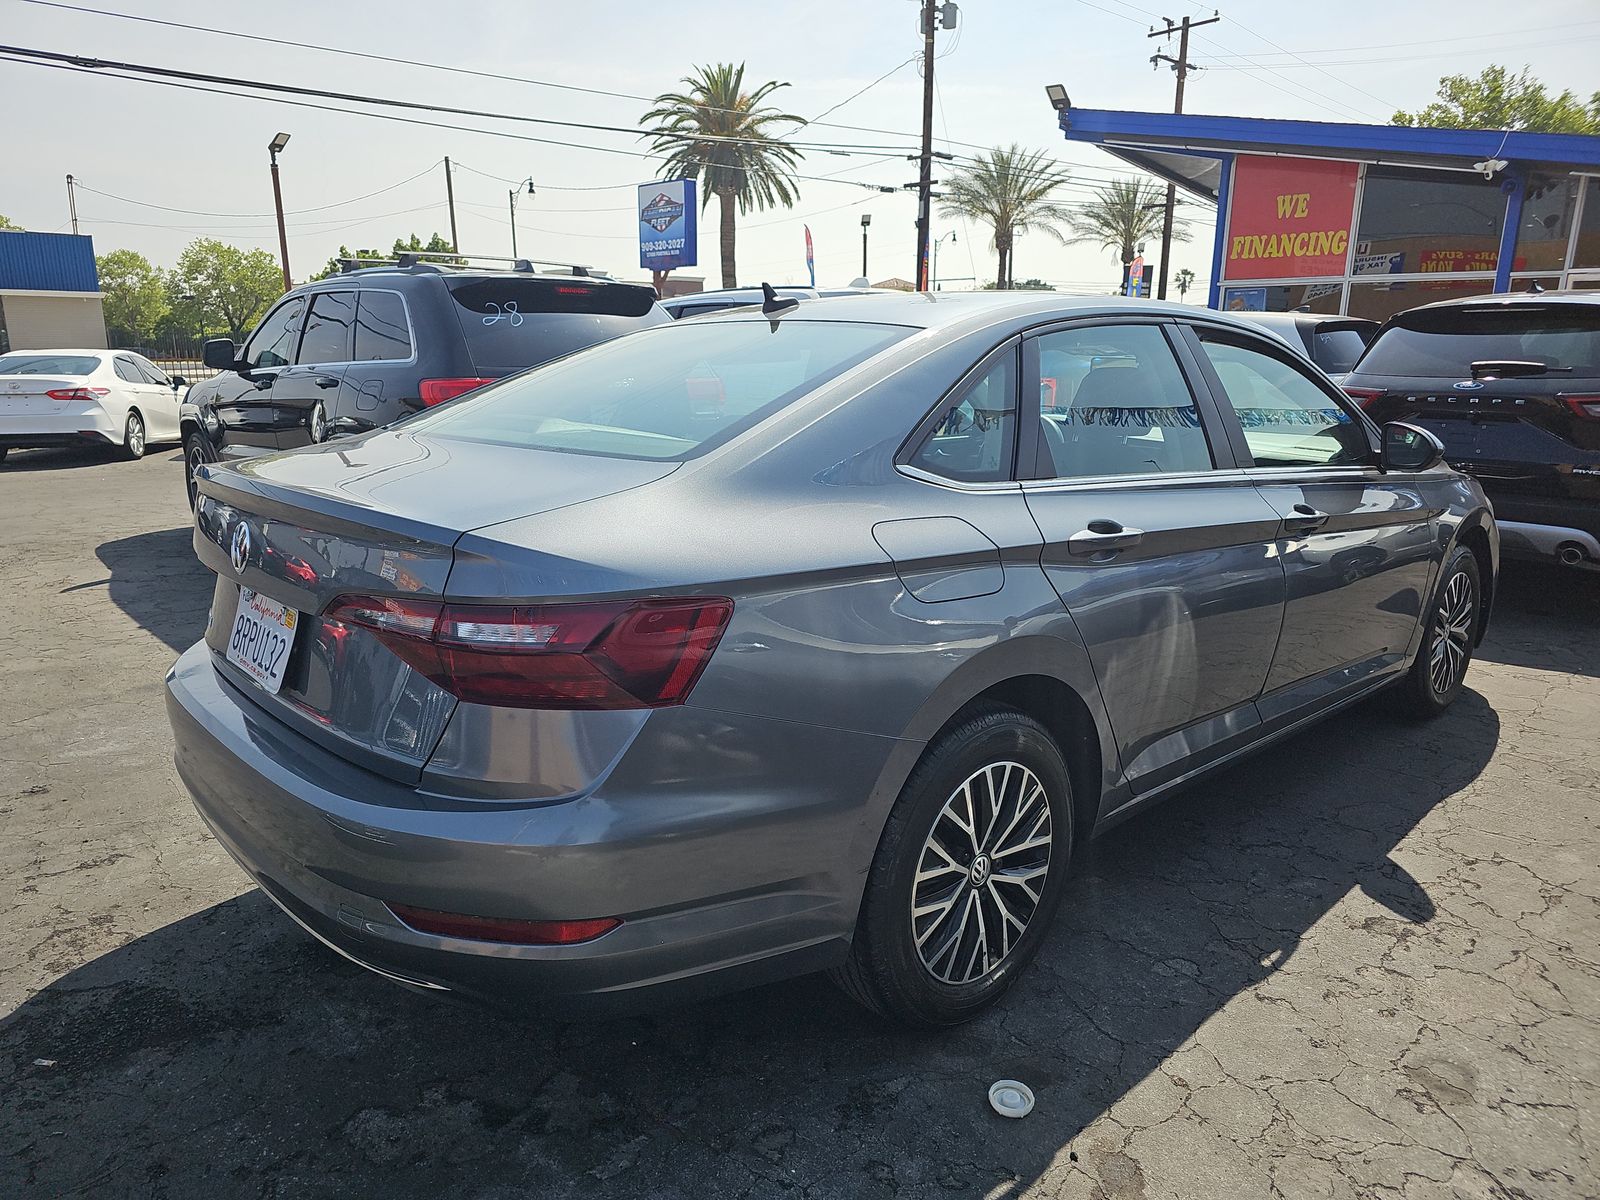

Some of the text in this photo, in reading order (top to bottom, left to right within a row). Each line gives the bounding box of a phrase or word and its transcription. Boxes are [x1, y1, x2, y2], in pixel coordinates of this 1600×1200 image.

[1277, 193, 1310, 219] WE
[641, 239, 685, 251] 909-320-2027
[1230, 230, 1348, 259] FINANCING
[482, 301, 524, 327] 28
[1407, 396, 1526, 405] ESCAPE
[232, 614, 287, 679] 8RPU132
